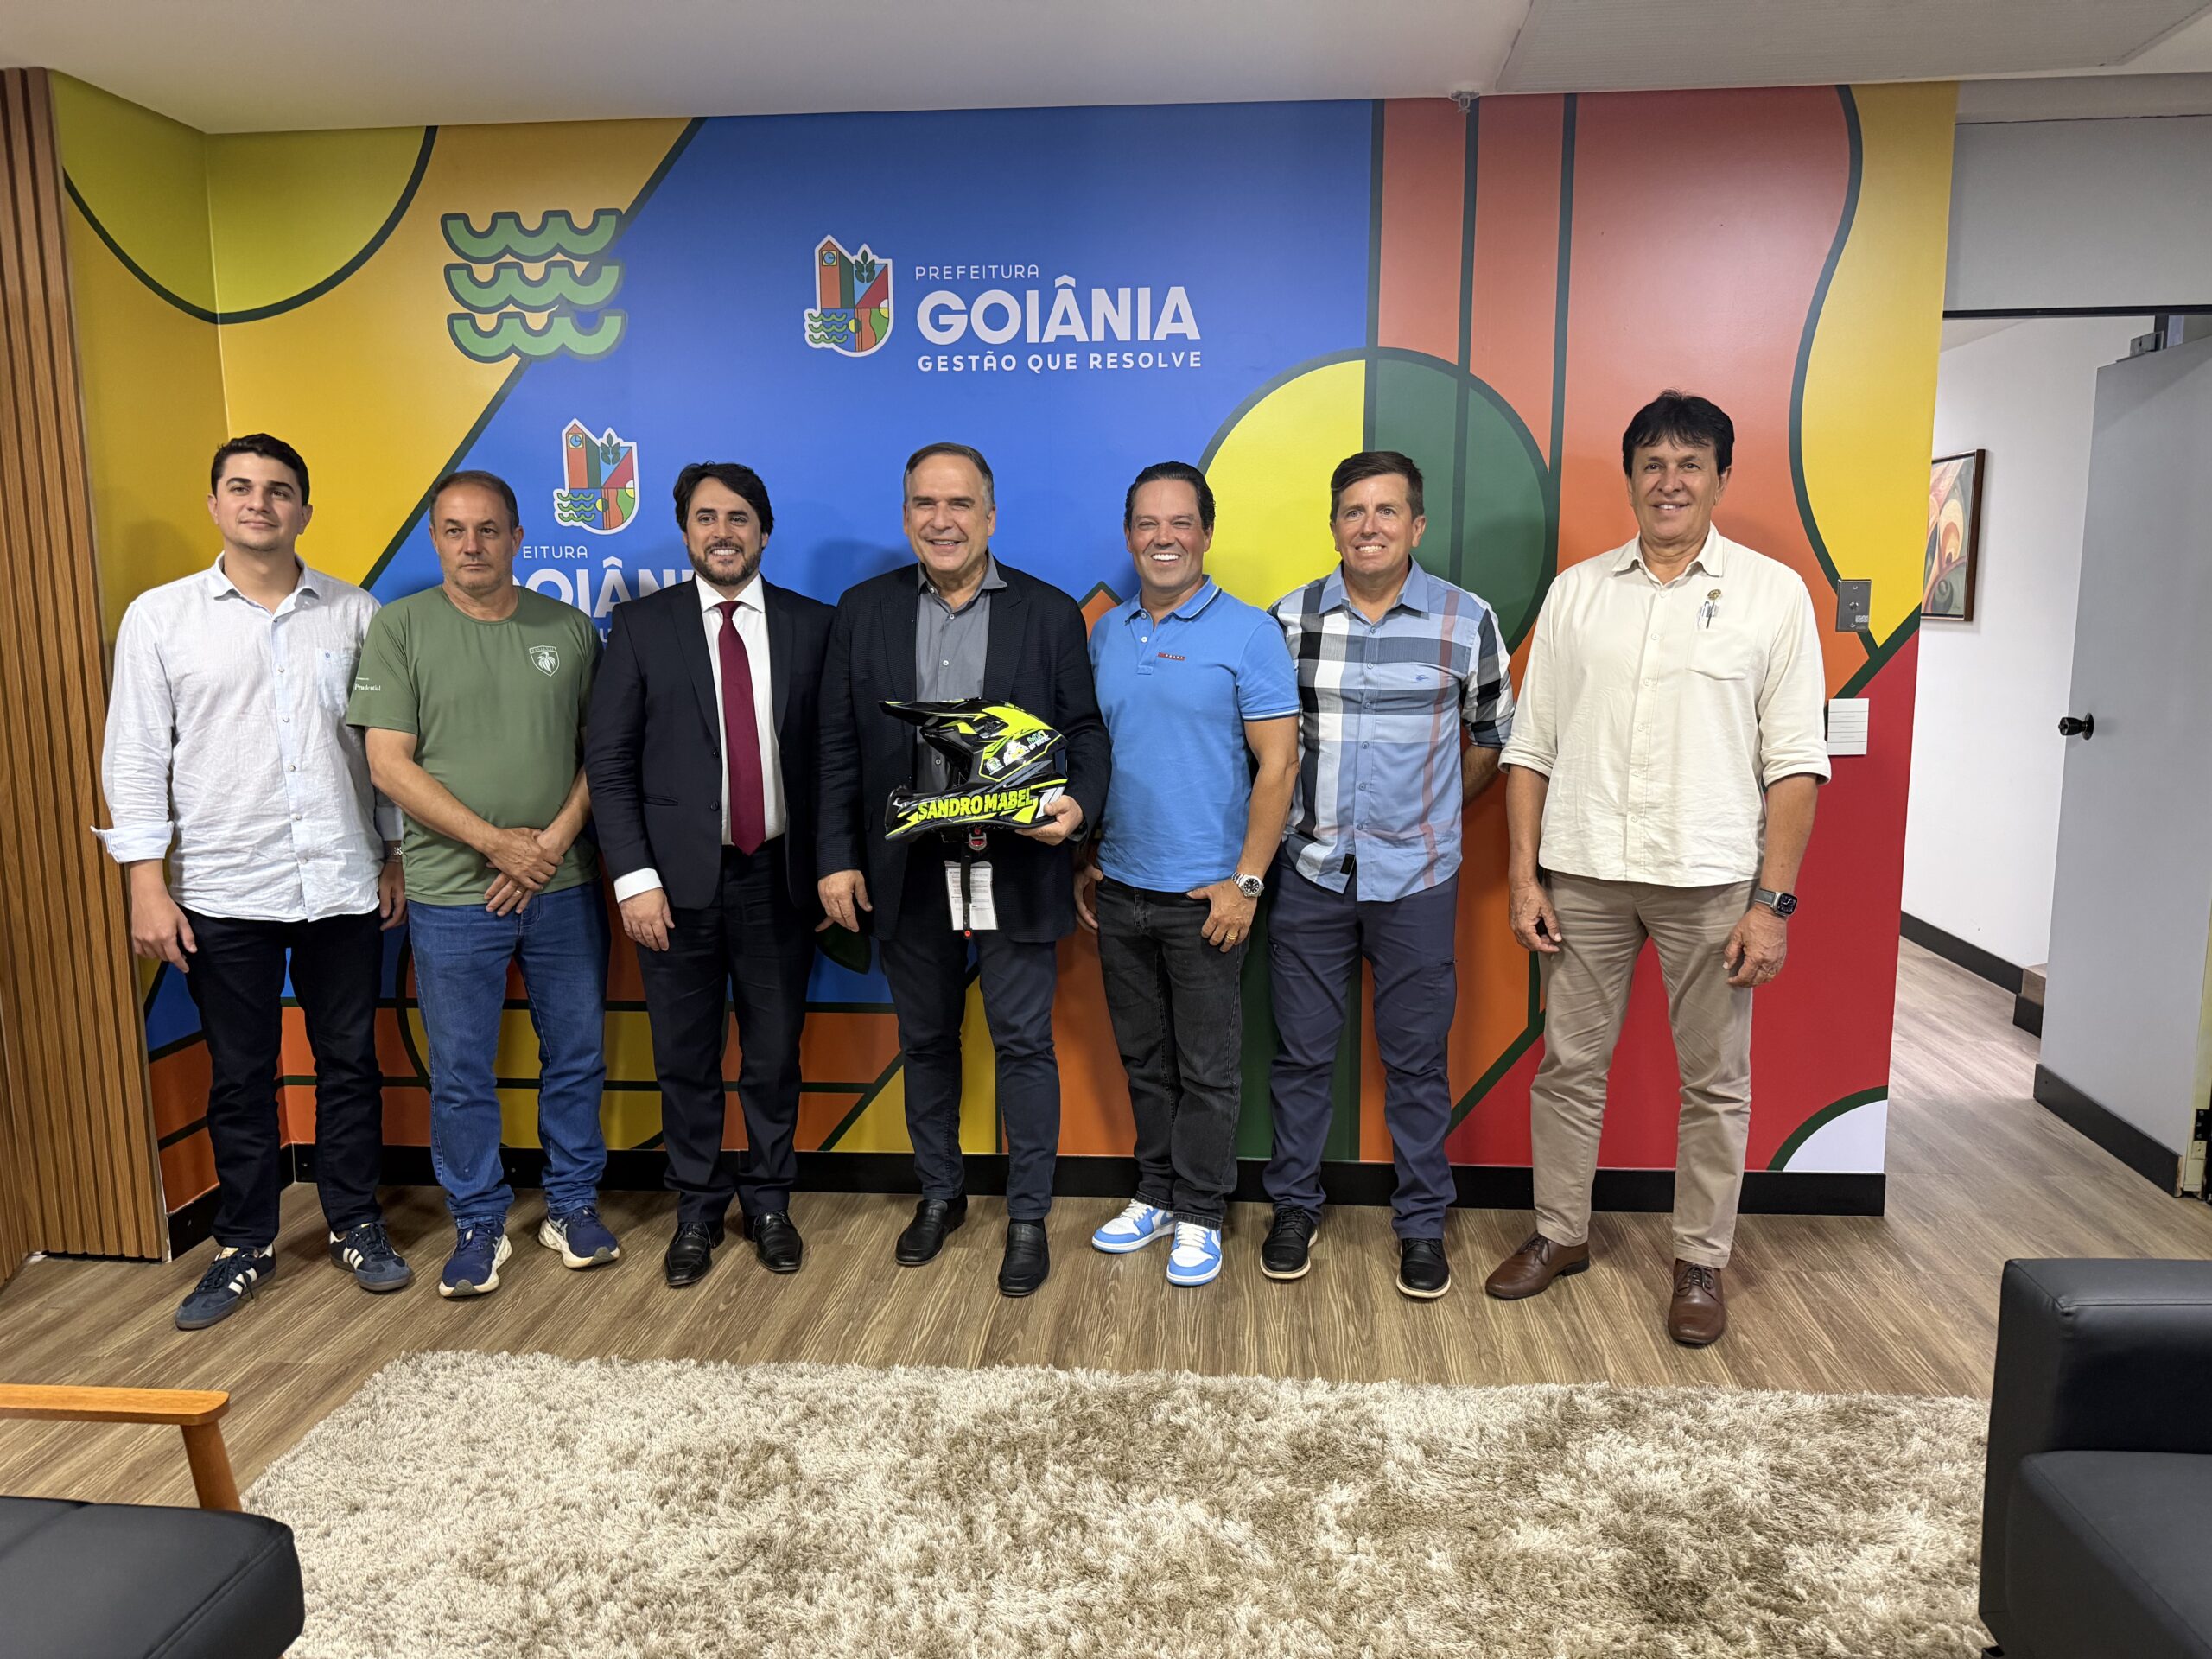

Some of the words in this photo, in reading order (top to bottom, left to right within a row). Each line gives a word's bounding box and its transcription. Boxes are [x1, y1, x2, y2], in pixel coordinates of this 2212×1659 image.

[915, 264, 1039, 281] PREFEITURA
[917, 274, 1201, 345] GOIÂNIA
[918, 350, 1017, 372] GESTÃO
[1027, 353, 1077, 374] QUE
[1089, 351, 1201, 370] RESOLVE
[522, 545, 588, 560] EITURA
[918, 795, 983, 822] SANDRO
[983, 787, 1034, 813] MABEL
